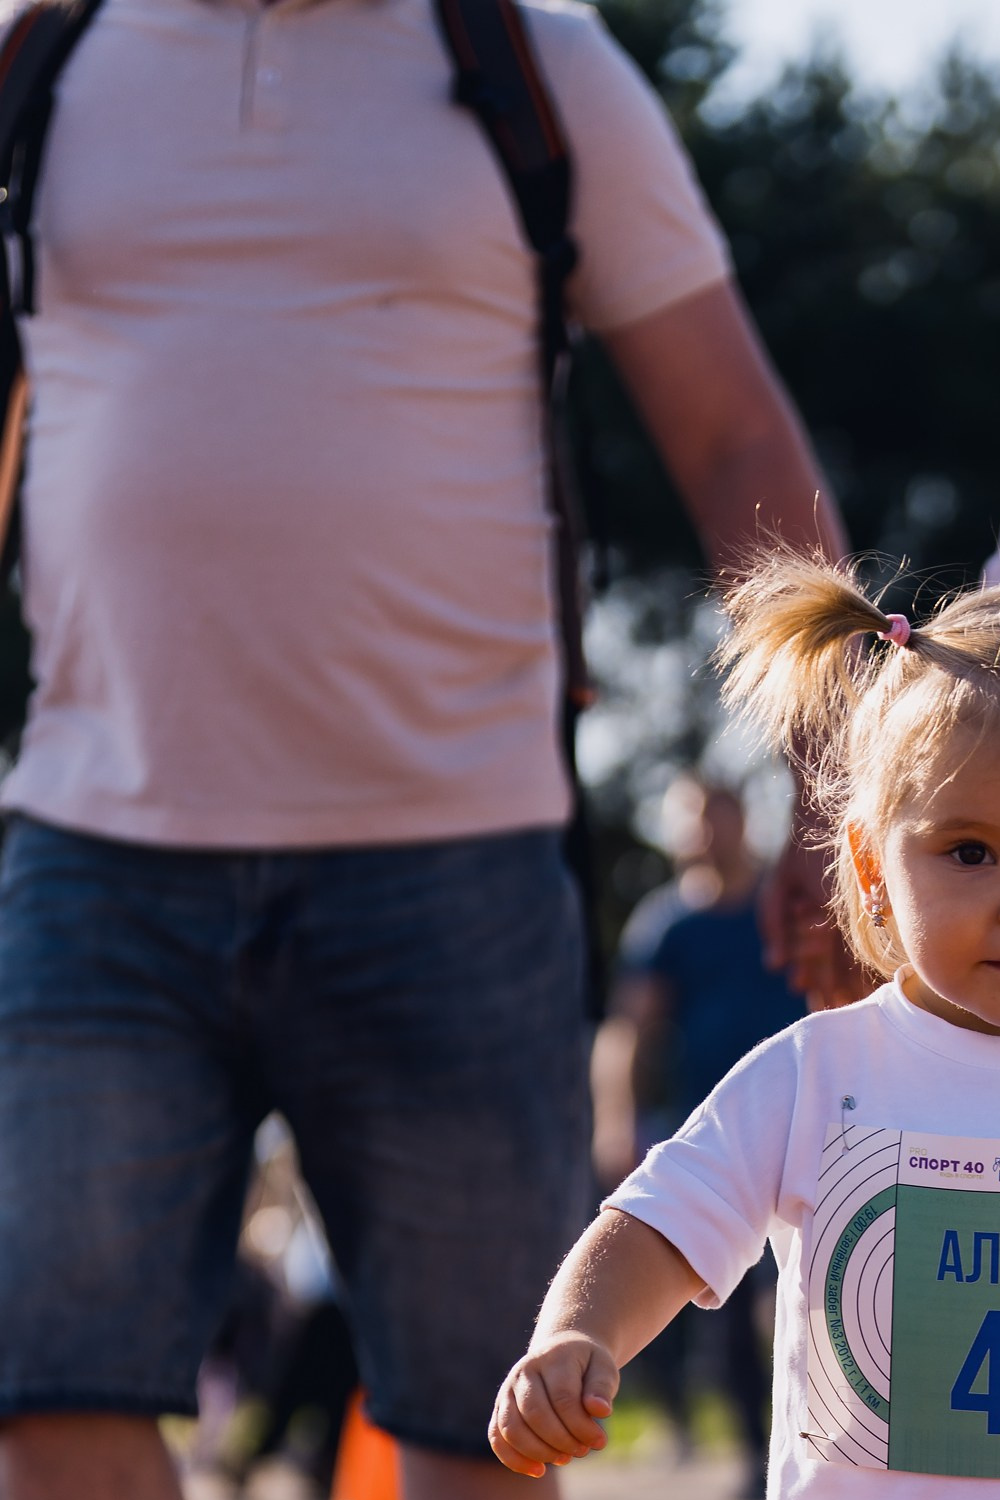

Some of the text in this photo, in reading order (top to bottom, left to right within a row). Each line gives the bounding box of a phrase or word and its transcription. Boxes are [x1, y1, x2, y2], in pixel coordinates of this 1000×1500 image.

[909, 1147, 928, 1156] PRO
[909, 1156, 985, 1174] СПОРТ 40
[853, 1205, 878, 1232] 19:00
[829, 1234, 853, 1282] зелёный
[828, 1284, 840, 1316] забег
[829, 1319, 844, 1339] №3
[834, 1340, 855, 1370] 2012
